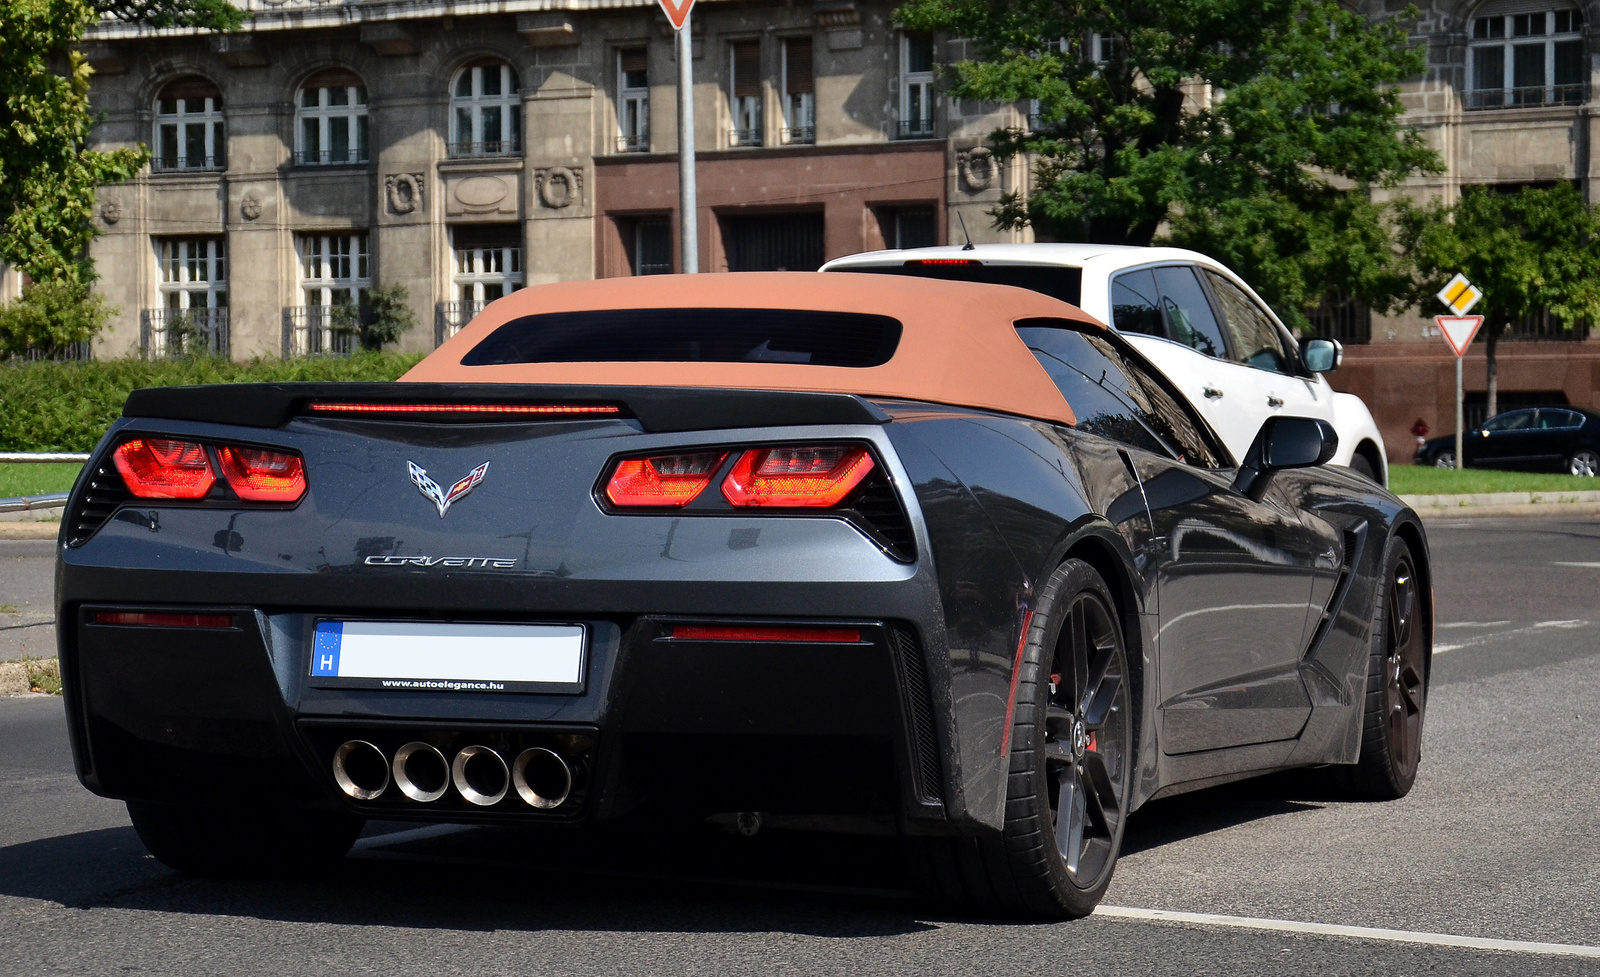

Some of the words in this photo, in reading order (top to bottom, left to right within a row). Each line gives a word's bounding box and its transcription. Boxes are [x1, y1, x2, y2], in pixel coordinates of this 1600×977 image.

[364, 555, 517, 568] CORVETTE
[320, 654, 333, 671] H
[381, 679, 505, 691] www.autoelegance.hu
